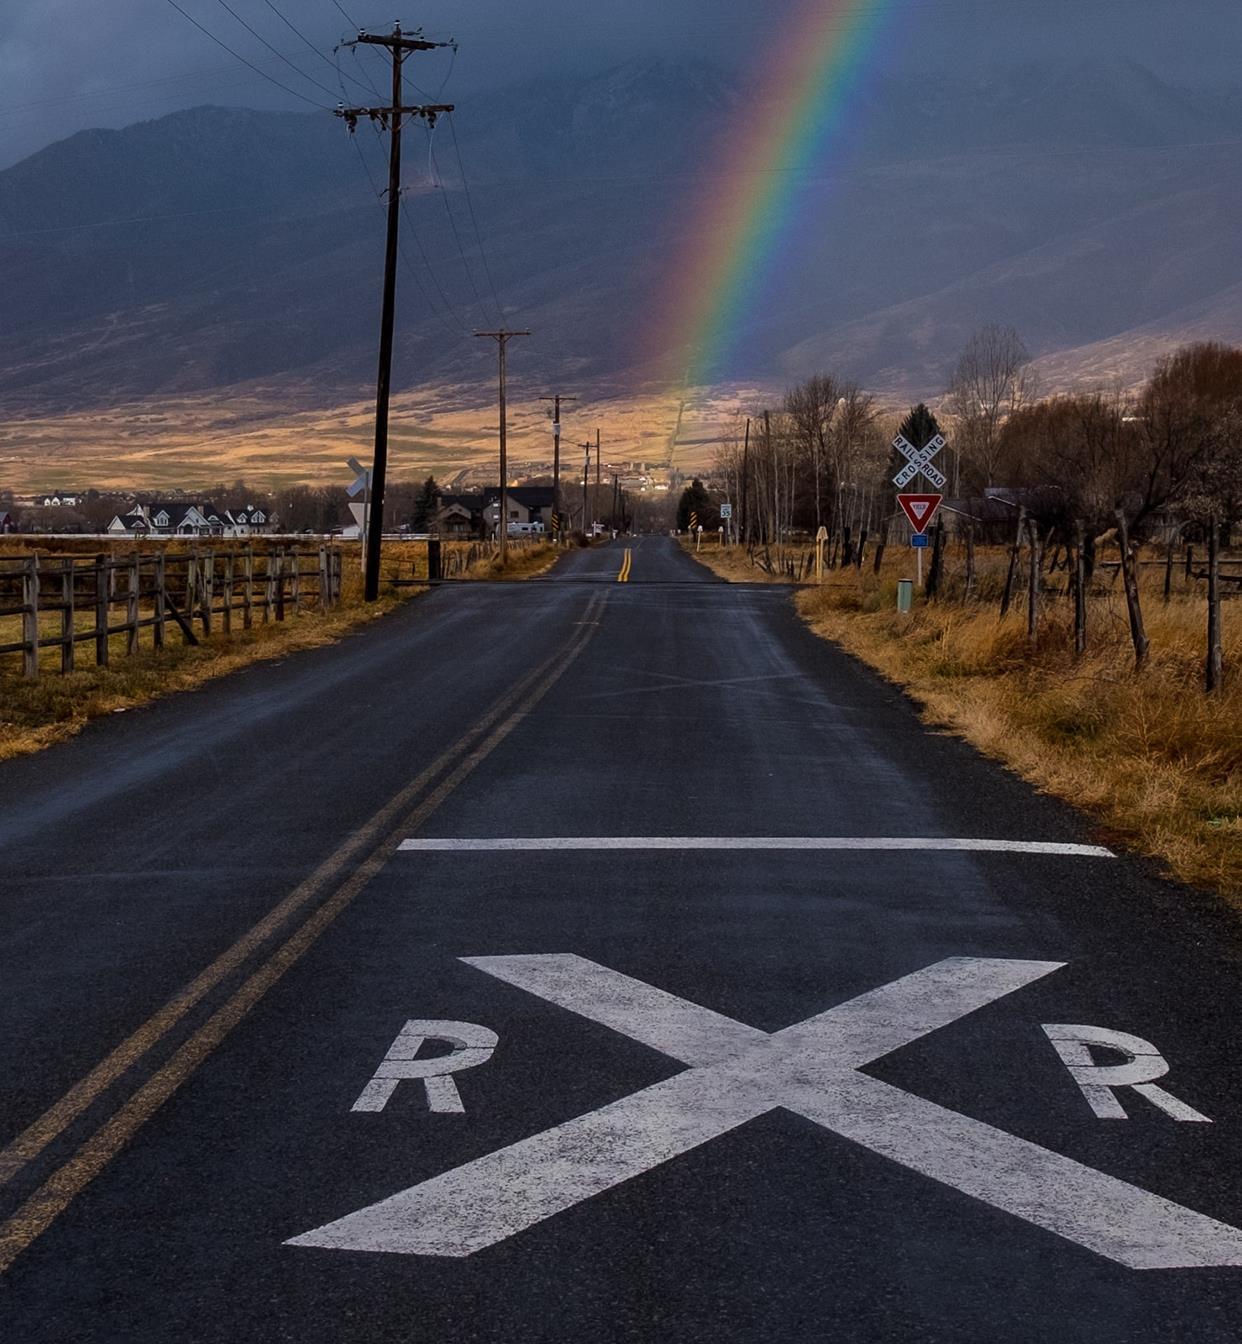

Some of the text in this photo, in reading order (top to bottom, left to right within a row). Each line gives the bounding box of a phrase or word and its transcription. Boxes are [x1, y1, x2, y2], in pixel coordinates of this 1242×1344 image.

[895, 437, 944, 485] CROSSING
[350, 1020, 499, 1113] R
[1040, 1024, 1213, 1123] R
